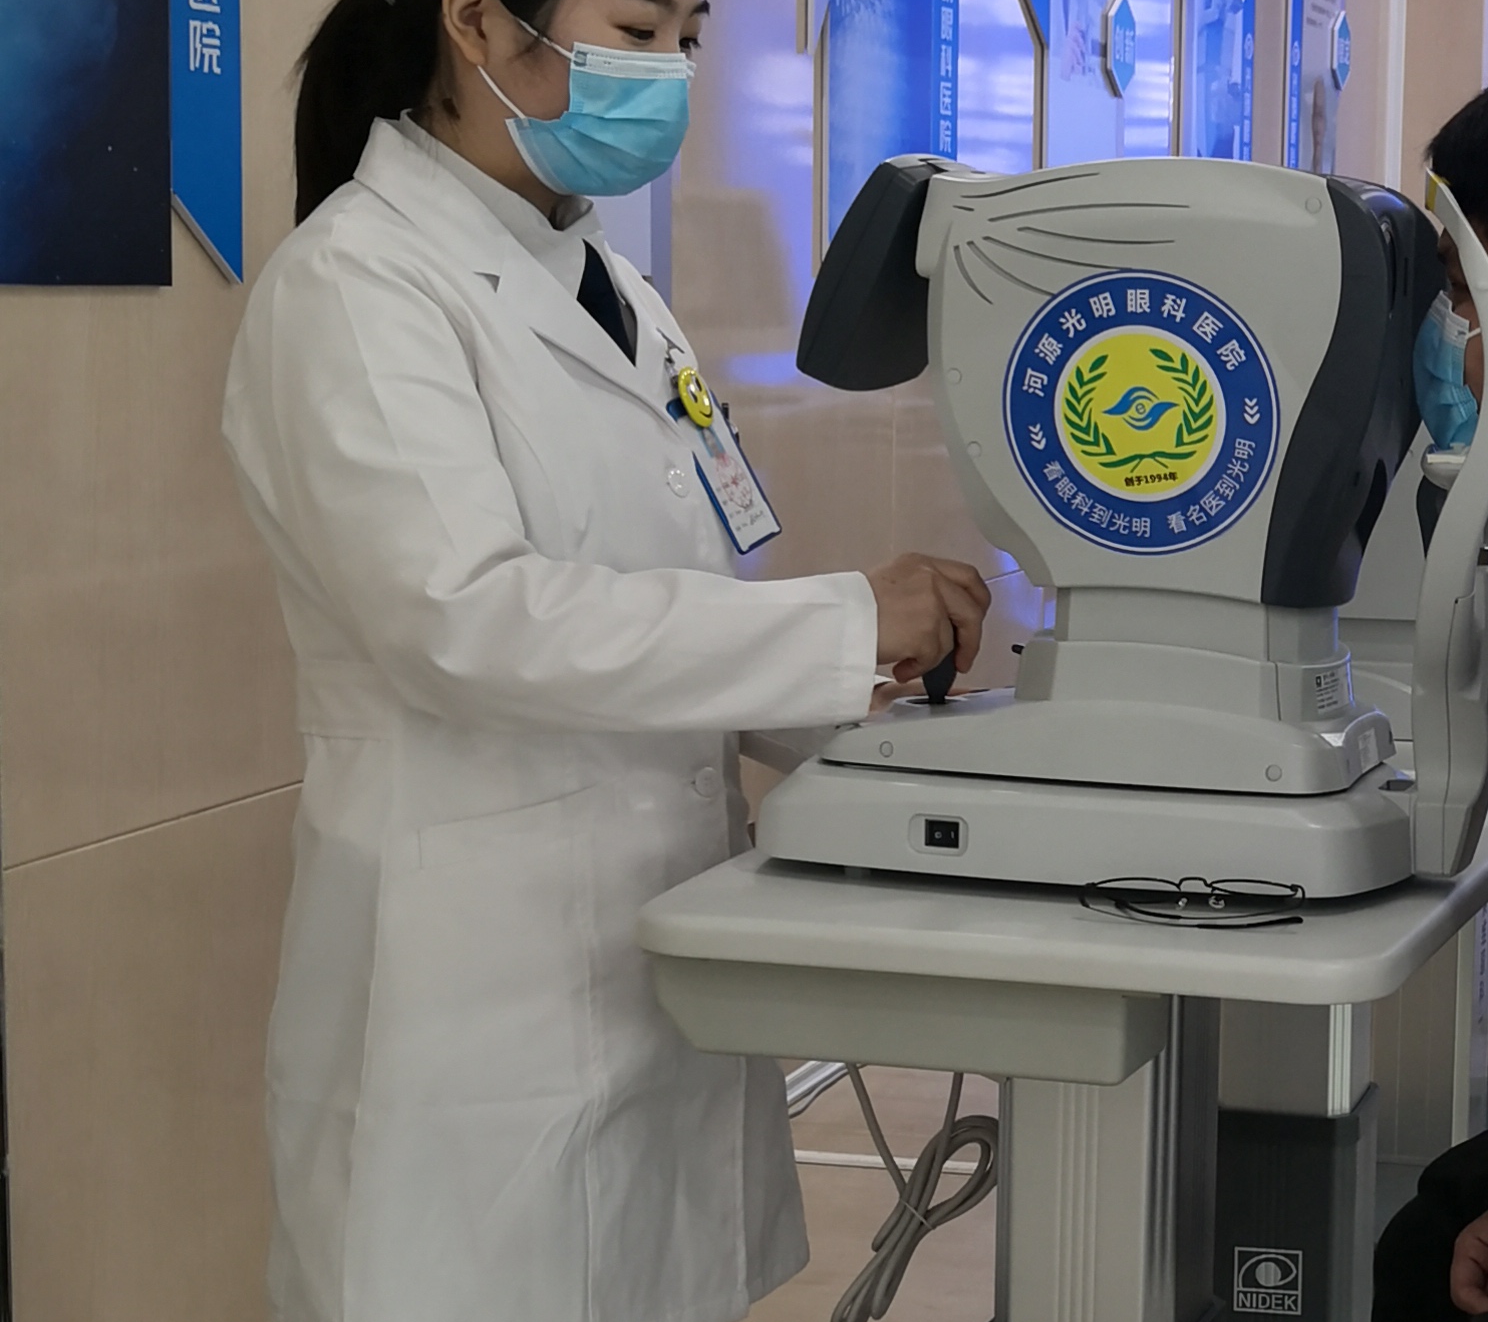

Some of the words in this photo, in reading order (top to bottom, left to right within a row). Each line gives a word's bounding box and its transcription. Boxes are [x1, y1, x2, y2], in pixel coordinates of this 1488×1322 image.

[1021, 287, 1249, 398] 河源光明眼科医院
[1041, 459, 1153, 539] 看眼科到光明
[1166, 437, 1257, 535] 看名医到光明
[1238, 1292, 1298, 1312] NIDEK
